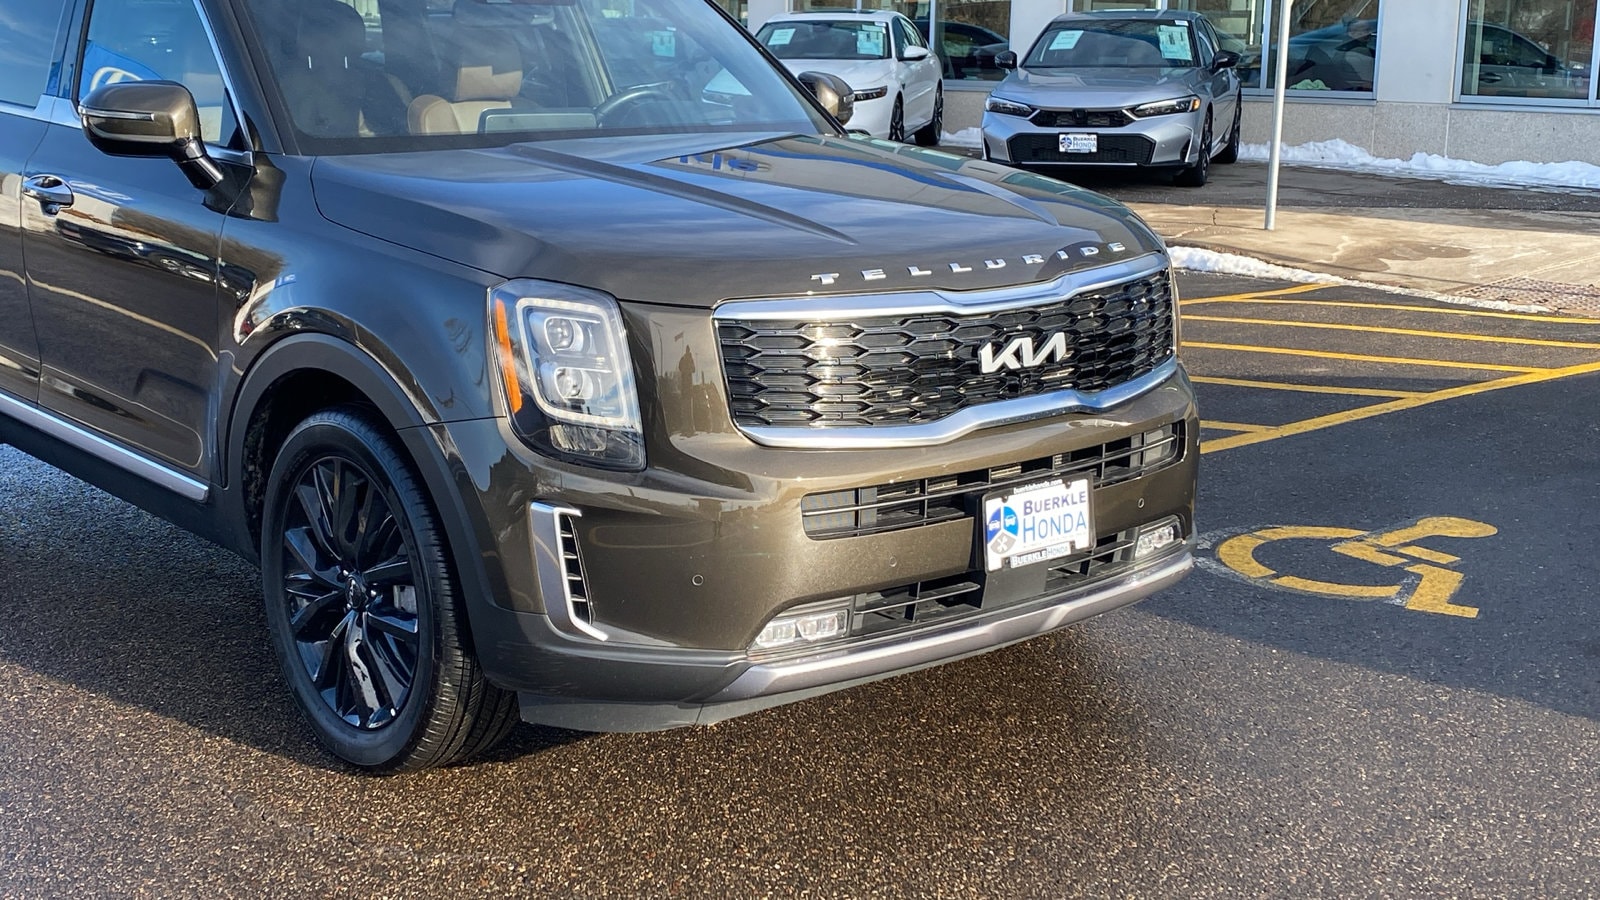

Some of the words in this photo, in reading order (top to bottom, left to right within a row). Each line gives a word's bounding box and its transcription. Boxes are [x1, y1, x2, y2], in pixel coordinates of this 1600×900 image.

[810, 241, 1126, 285] TELLURIDE
[979, 332, 1066, 374] KIA
[1023, 491, 1087, 516] BUERKLE
[1023, 511, 1087, 543] HONDA
